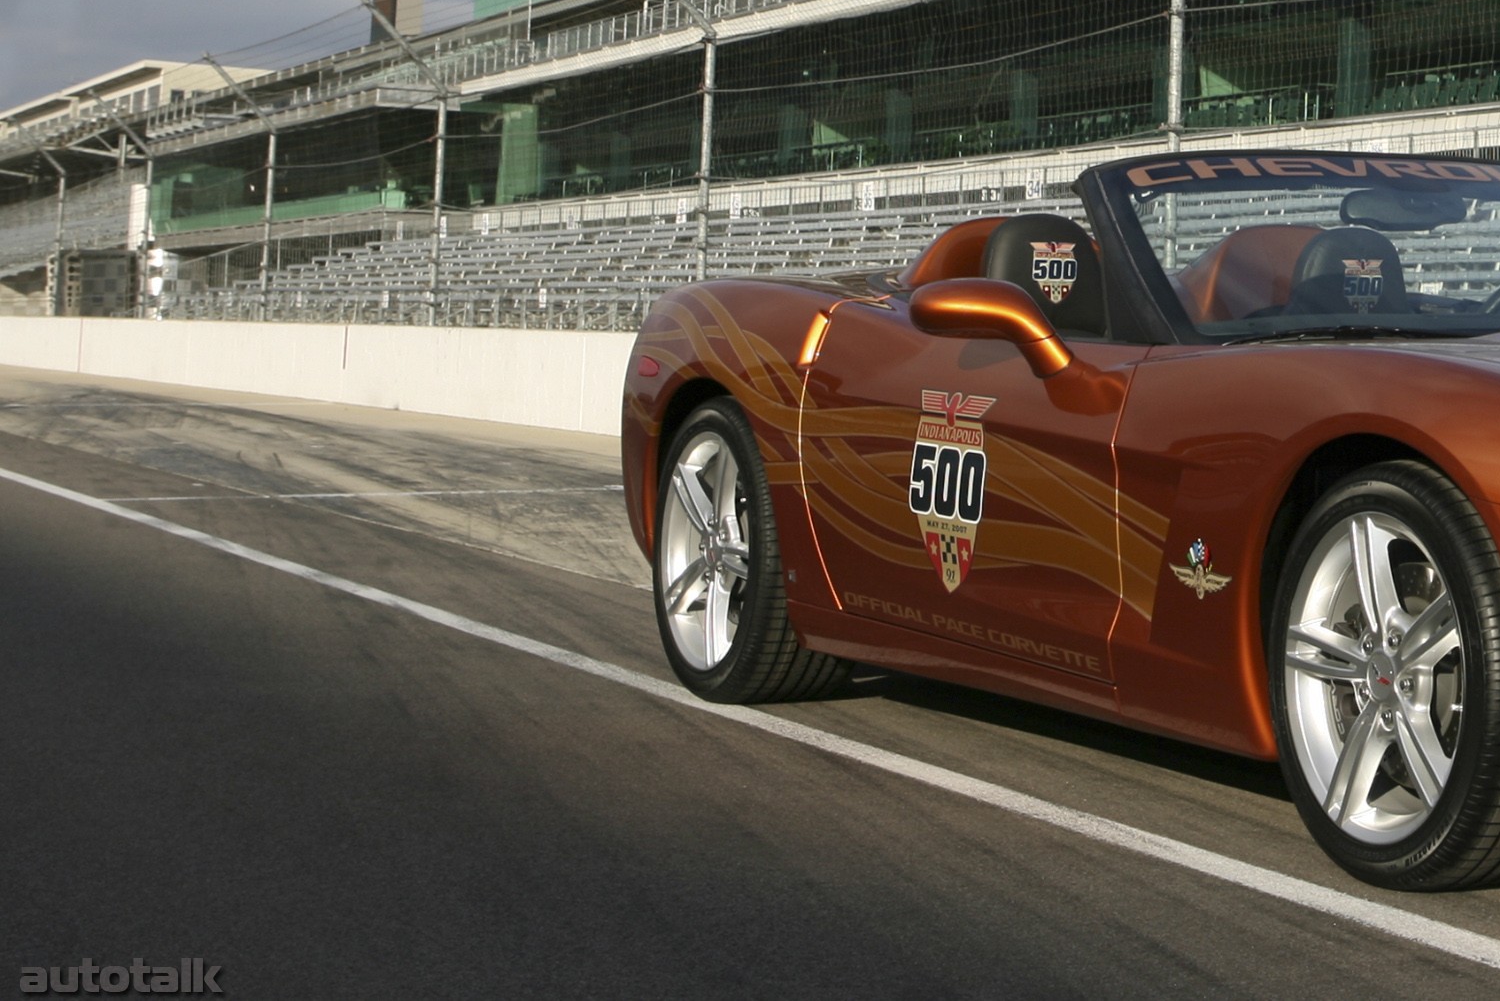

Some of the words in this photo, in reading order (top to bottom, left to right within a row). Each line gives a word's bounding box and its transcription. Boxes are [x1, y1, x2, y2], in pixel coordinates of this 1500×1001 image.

[1033, 259, 1077, 280] 500
[1344, 276, 1383, 296] 500
[920, 424, 980, 444] INDIANAPOLIS
[909, 442, 986, 524] 500
[927, 520, 939, 529] MAY
[952, 524, 967, 534] 2007
[946, 569, 955, 581] 91
[844, 591, 930, 625] OFFICIAL
[932, 614, 985, 641] PACE
[987, 629, 1101, 672] CORVETTE
